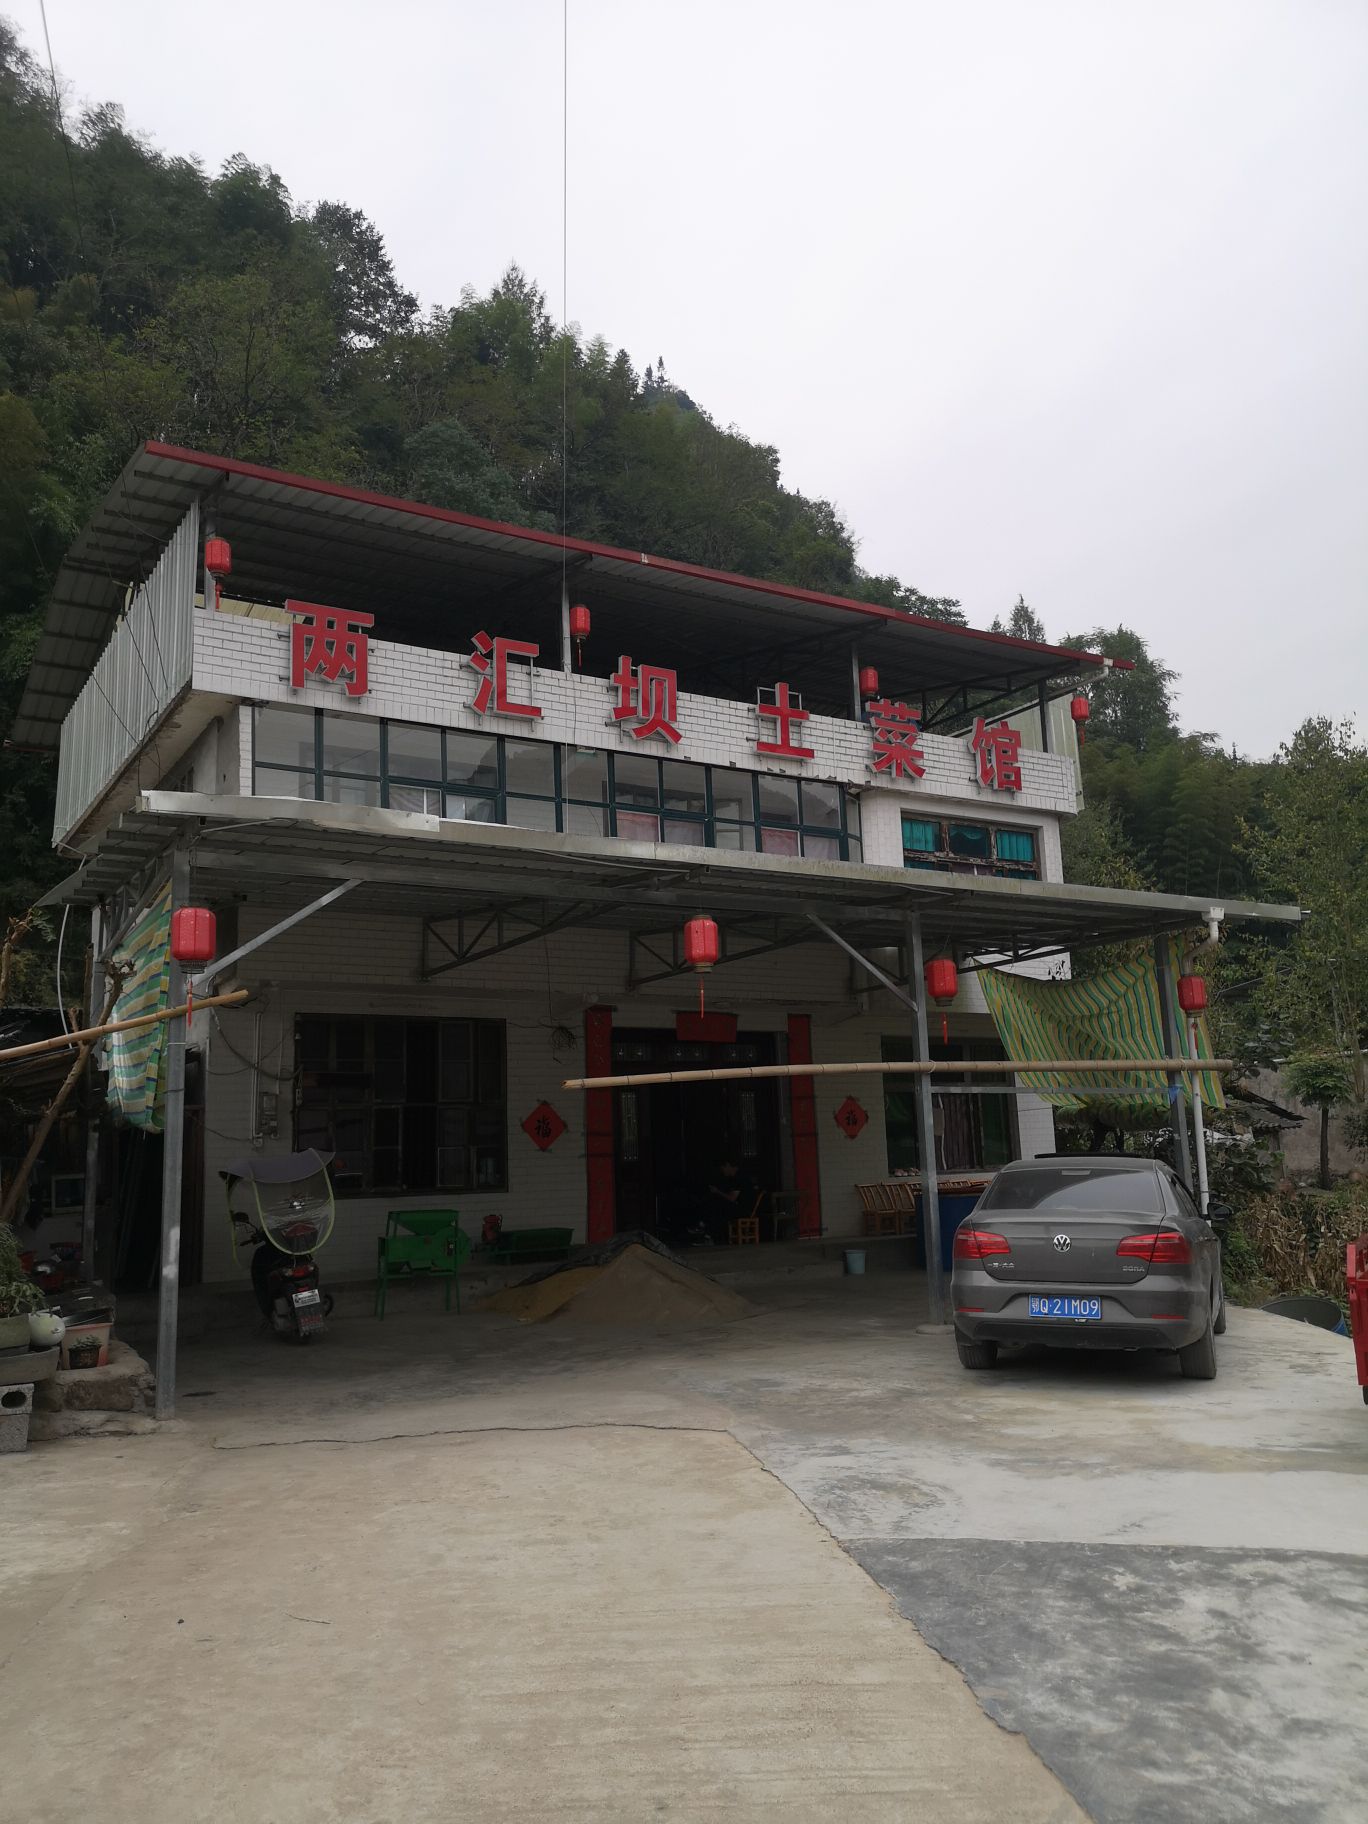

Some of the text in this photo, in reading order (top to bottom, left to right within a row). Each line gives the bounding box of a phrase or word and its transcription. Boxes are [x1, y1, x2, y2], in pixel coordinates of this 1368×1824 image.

[285, 599, 1022, 792] 两汇坝土菜馆
[534, 1115, 552, 1138] 福
